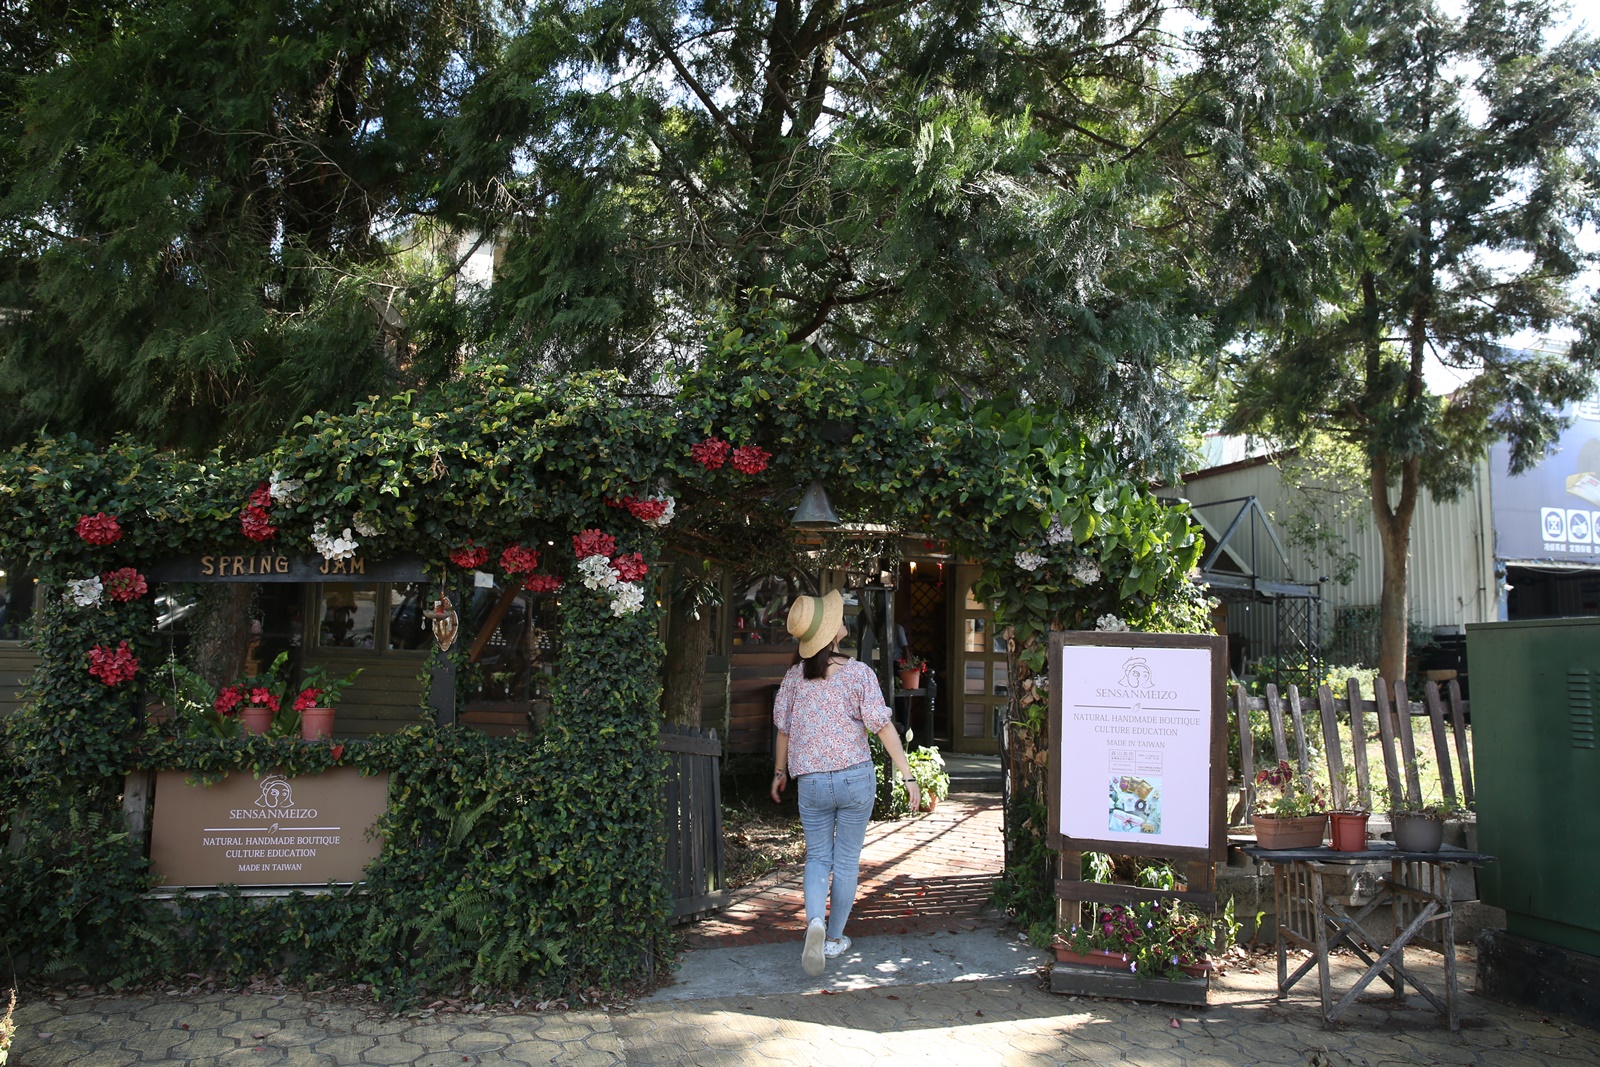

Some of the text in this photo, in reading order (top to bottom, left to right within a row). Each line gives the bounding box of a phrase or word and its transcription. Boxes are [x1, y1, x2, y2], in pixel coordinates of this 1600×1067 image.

[201, 555, 365, 576] SPRING JAM
[1095, 688, 1178, 700] SENSANMEIZO
[1073, 713, 1201, 726] NATURAL HANDMADE BOUTIQUE
[1094, 725, 1178, 736] CULTURE EDUCATION
[1106, 739, 1127, 747] MADE
[1137, 740, 1166, 749] TAIWAN
[229, 808, 318, 820] SENSANMEIZO
[203, 836, 341, 846] NATURAL HANDMADE BOUTIQUE
[225, 848, 316, 858] CULTURE EDUCATION
[238, 863, 302, 872] MADE IN TAIWAN
